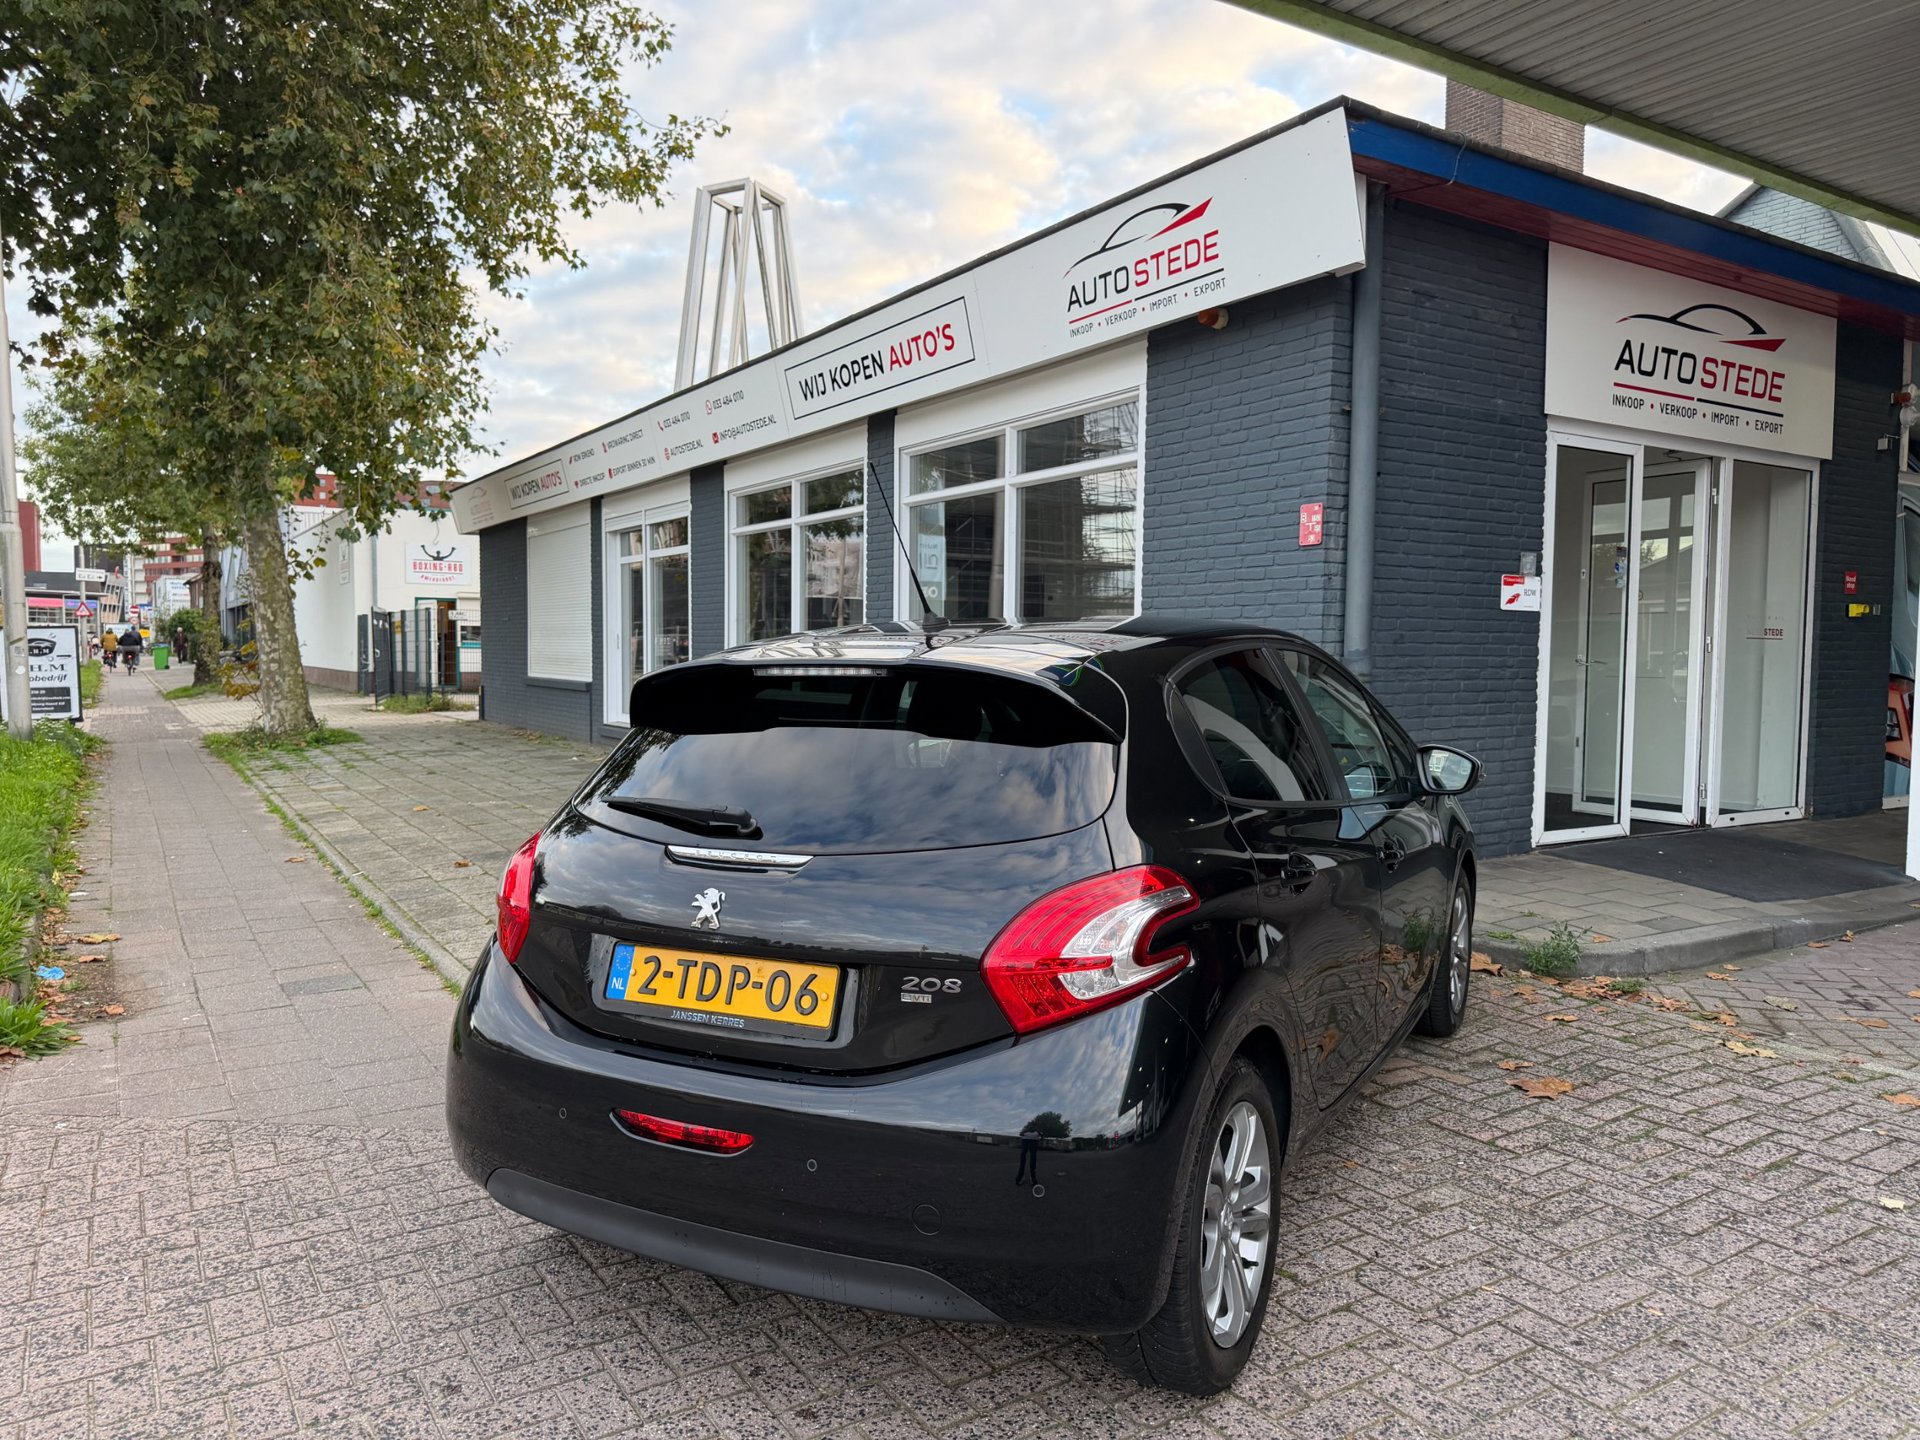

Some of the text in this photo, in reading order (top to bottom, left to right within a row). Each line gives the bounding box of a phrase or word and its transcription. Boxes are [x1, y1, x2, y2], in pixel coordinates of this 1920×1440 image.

[1067, 229, 1219, 312] AUTOSTEDE
[1069, 278, 1226, 338] INKOOP VERKOOP IMPORT EXPORT
[799, 323, 955, 401] WIJ KOPEN AUTO'S
[1614, 339, 1786, 403] AUTOSTEDE
[719, 414, 777, 441] INFO@AUTOSTEDE.NL
[1612, 394, 1784, 435] INKOOP VERKOOP IMPORT EXPORT
[670, 438, 704, 456] AUTOSTEDE.NL
[510, 470, 562, 501] WIJ KOPEN AUTO'S
[29, 673, 68, 683] obedrijf
[611, 977, 625, 990] NL
[637, 954, 819, 1016] 2-TDP-06
[900, 976, 962, 993] 208
[670, 1010, 745, 1028] JANSSEN KERRES
